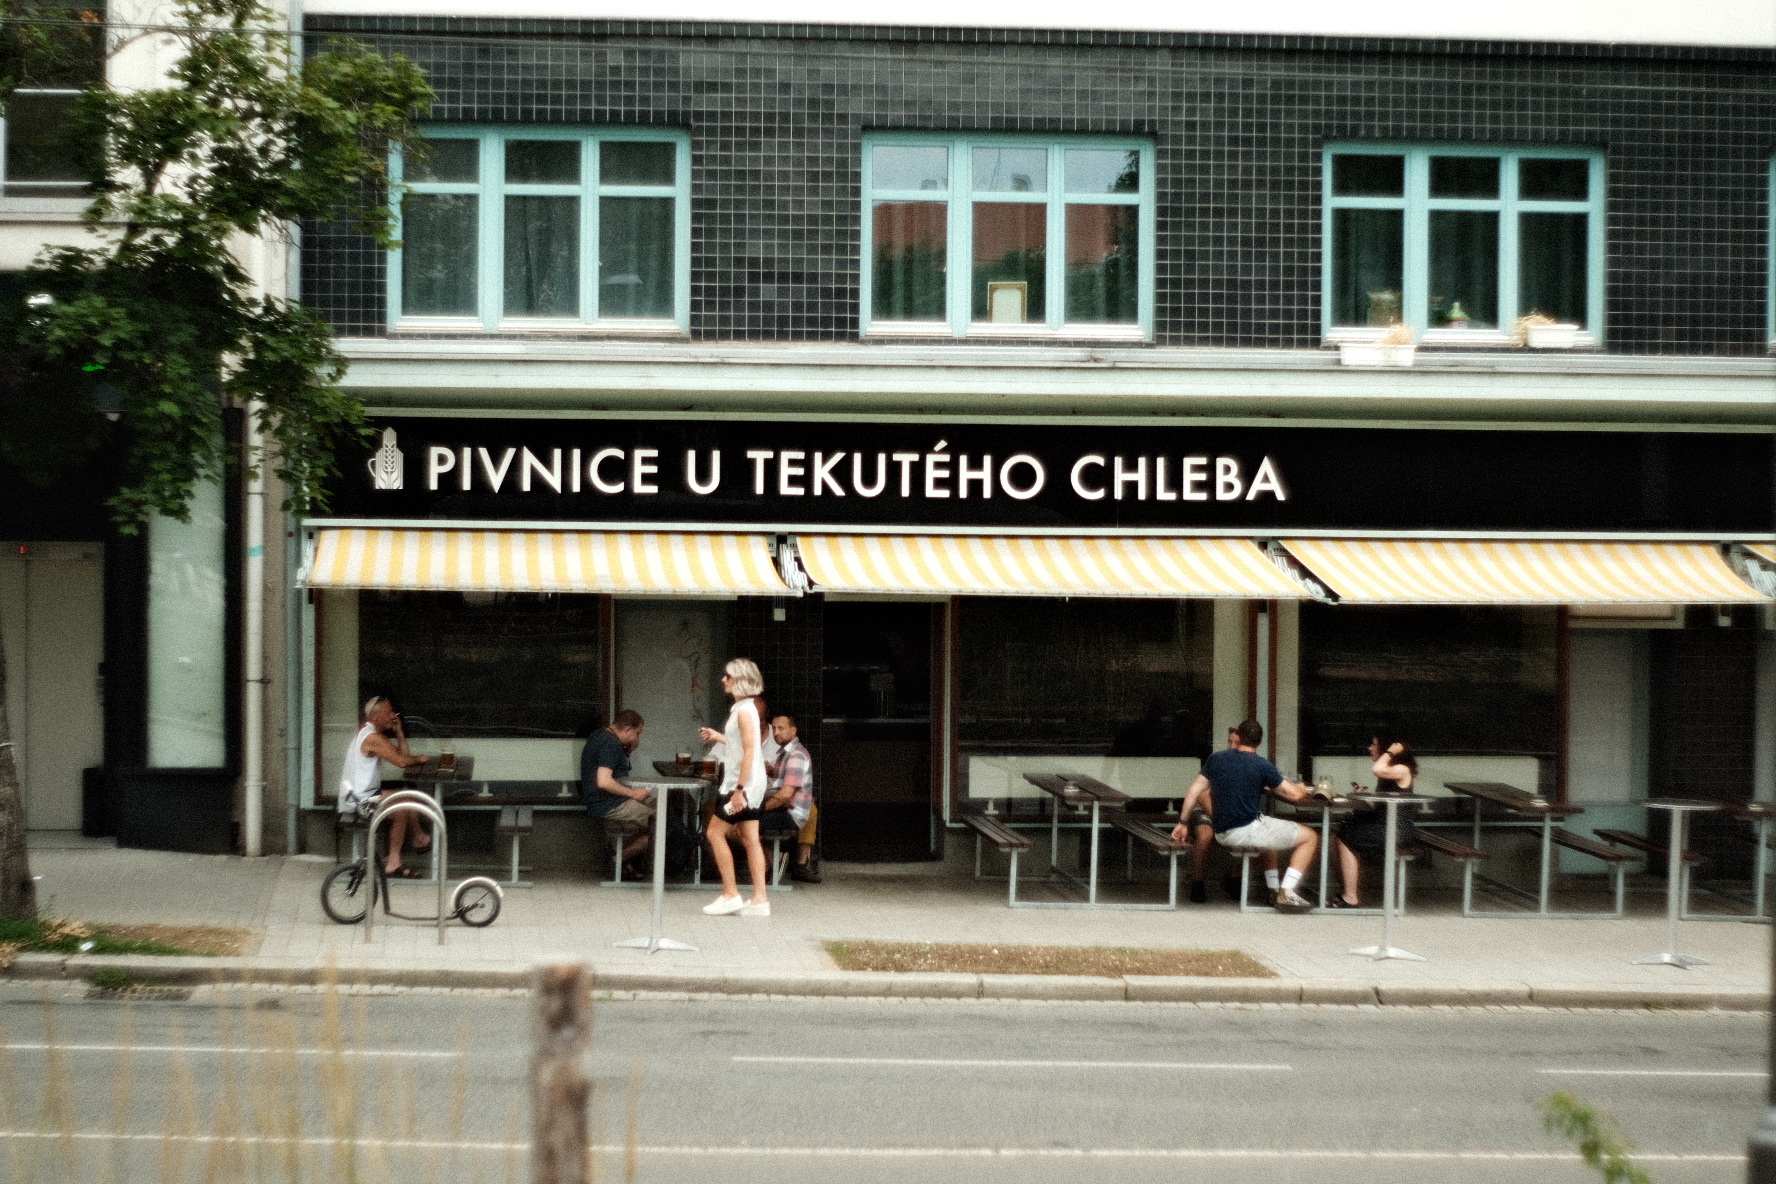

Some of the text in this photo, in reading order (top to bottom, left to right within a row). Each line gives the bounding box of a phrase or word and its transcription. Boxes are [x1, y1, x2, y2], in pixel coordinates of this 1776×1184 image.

[428, 439, 1287, 502] PIVNICE U TEKUTÉHO CHLEBA
